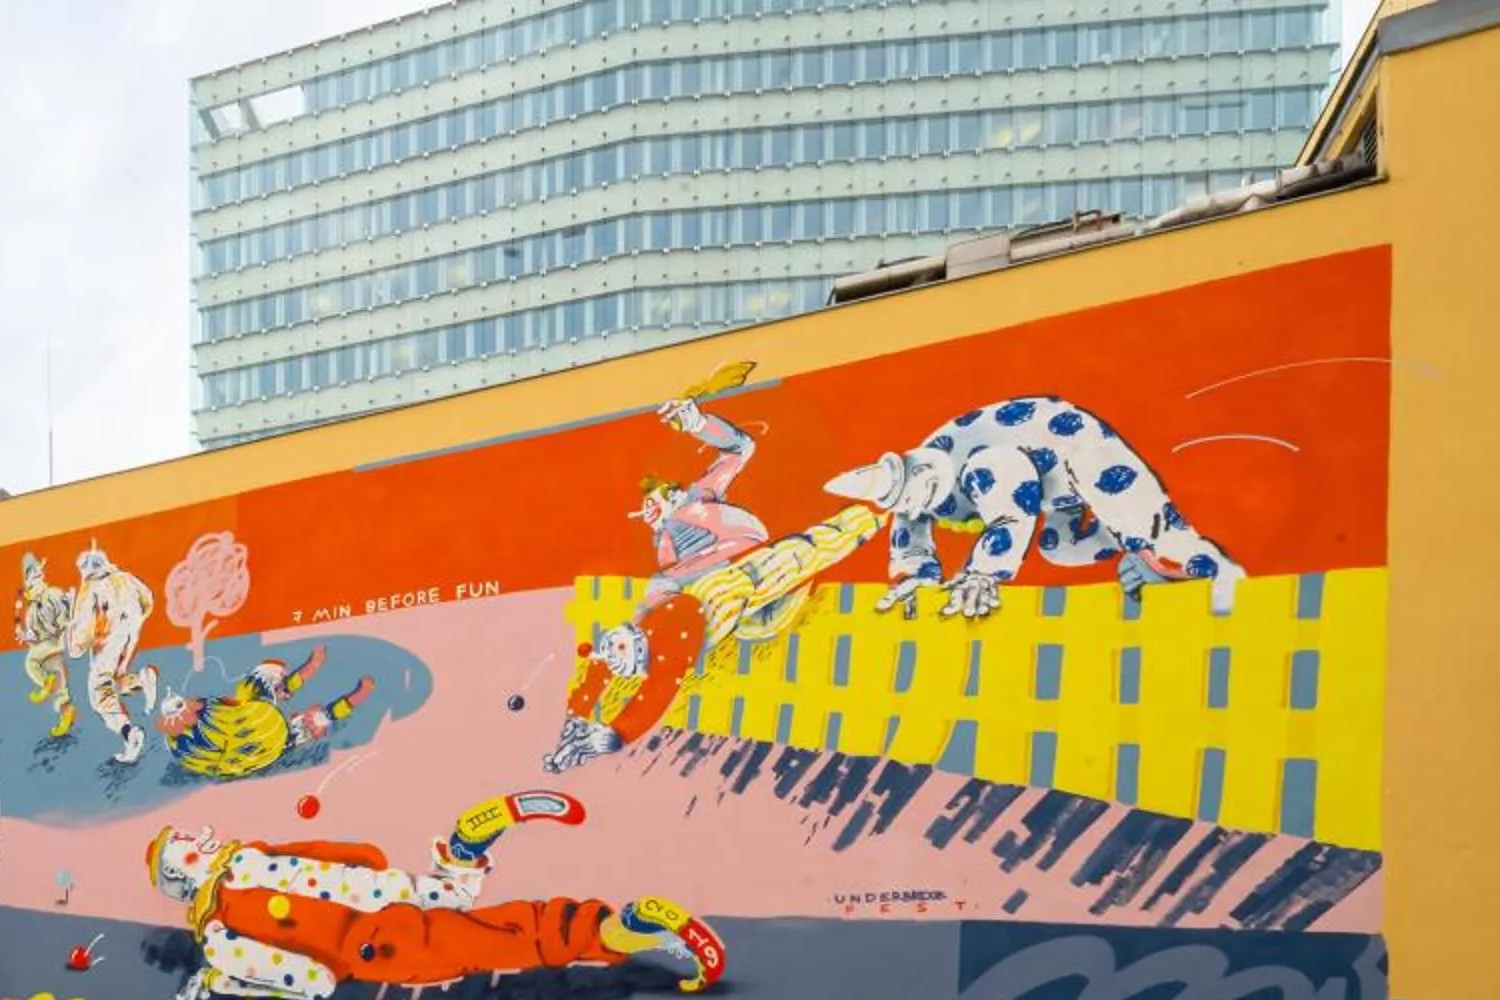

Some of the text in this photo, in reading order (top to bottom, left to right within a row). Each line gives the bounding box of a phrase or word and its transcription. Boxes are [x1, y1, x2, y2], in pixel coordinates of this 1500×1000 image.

[312, 603, 351, 622] MIN
[365, 587, 440, 614] BEFORE
[456, 580, 499, 600] FUN
[844, 901, 966, 914] FEST
